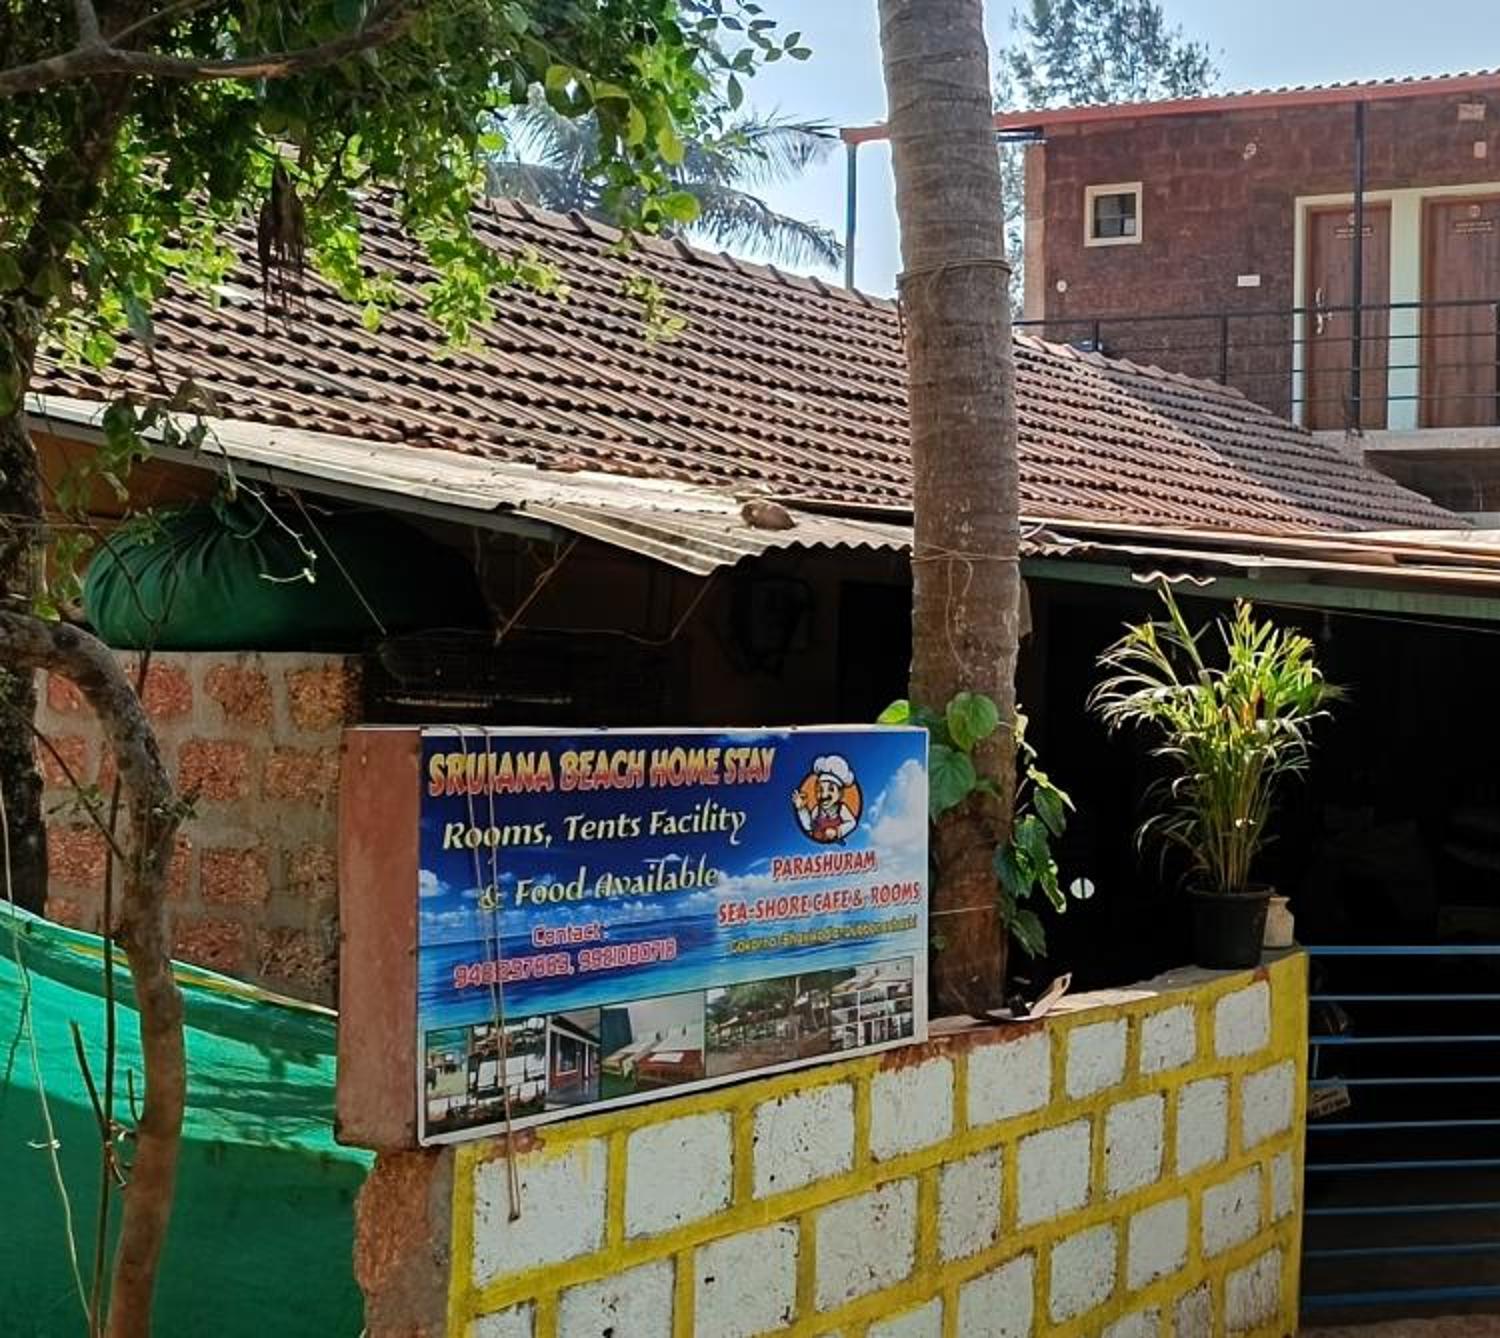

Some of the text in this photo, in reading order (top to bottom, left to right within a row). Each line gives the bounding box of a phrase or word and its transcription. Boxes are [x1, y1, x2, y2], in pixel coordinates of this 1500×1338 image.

[559, 750, 646, 790] BEACH
[650, 747, 721, 786] HOME
[724, 747, 776, 784] STAY
[443, 798, 747, 849] Rooms, Tents Facility
[480, 853, 720, 909] & Food Available
[771, 850, 878, 880] PARASHURAM
[718, 881, 921, 926] SEA-SHORE CAFE & ROOMS
